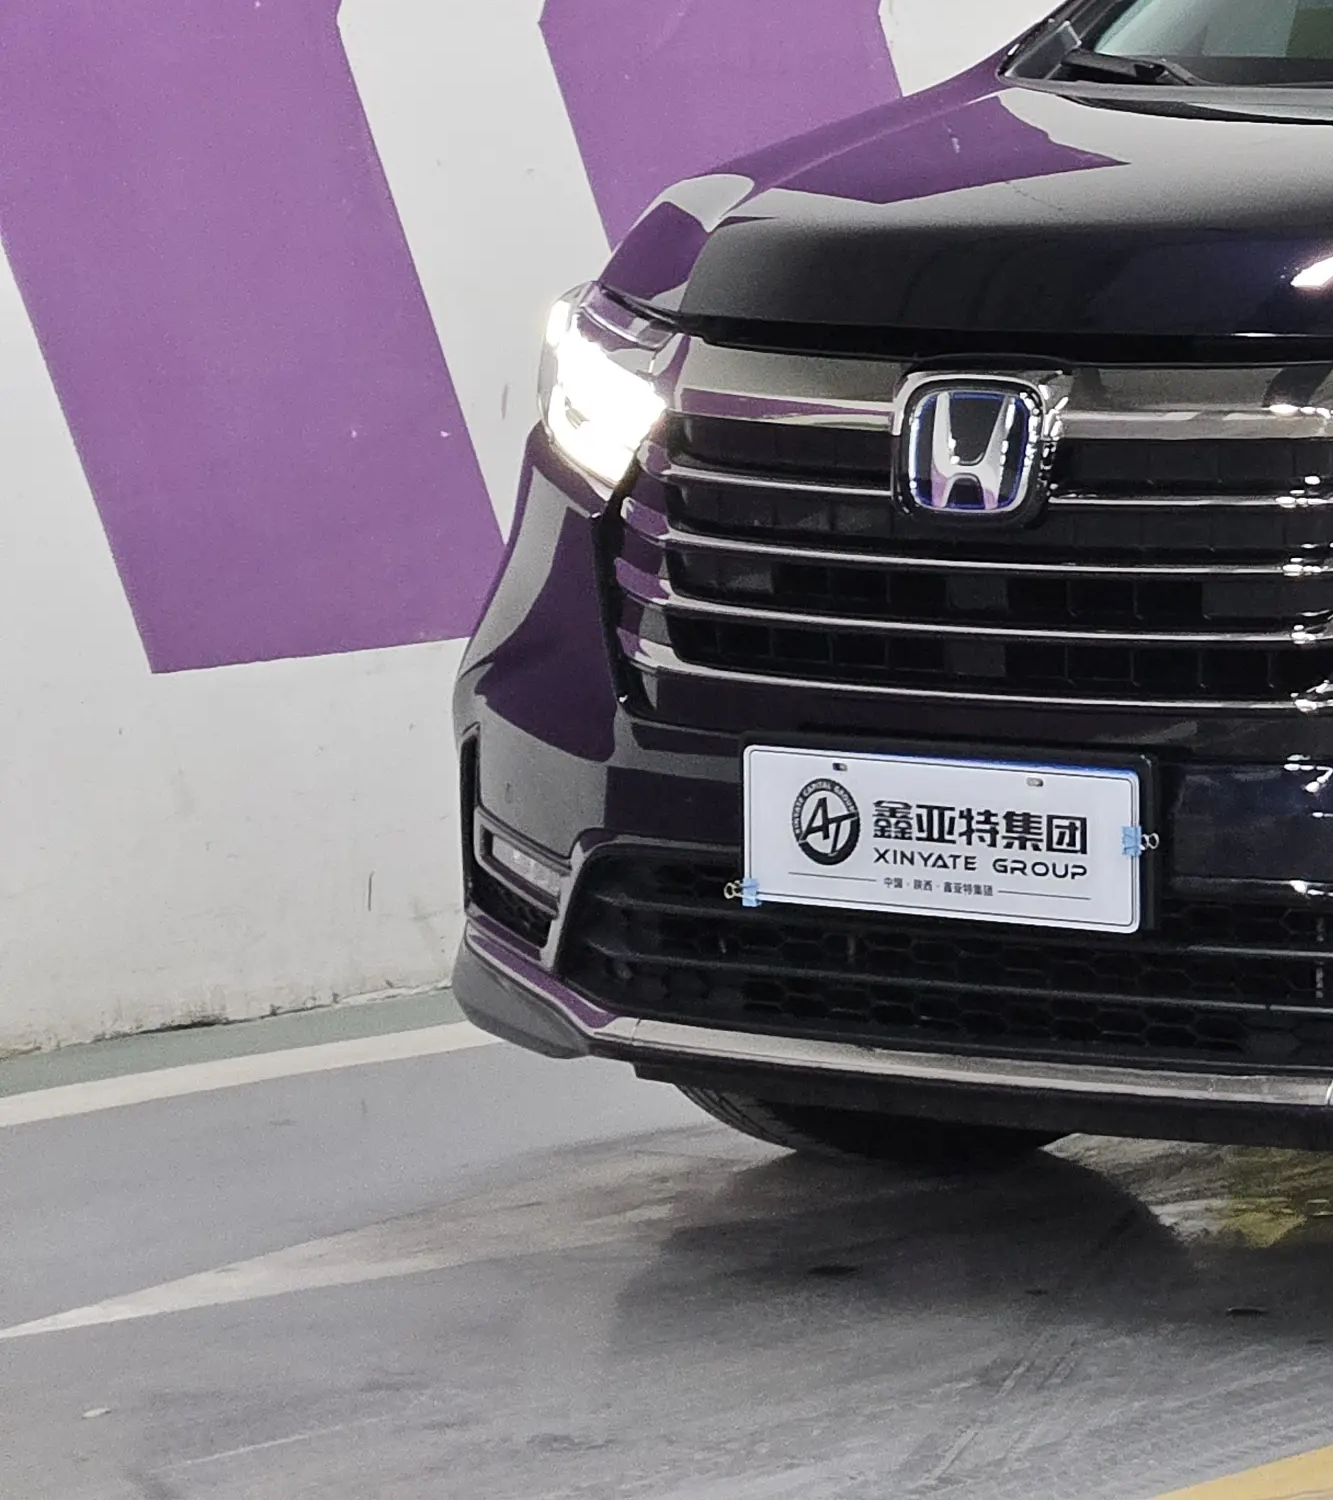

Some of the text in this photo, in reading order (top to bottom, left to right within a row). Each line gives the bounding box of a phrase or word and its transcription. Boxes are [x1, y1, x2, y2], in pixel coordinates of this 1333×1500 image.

[872, 799, 1088, 855] 鑫亚特集团
[873, 847, 1088, 880] XINYATE GROUP
